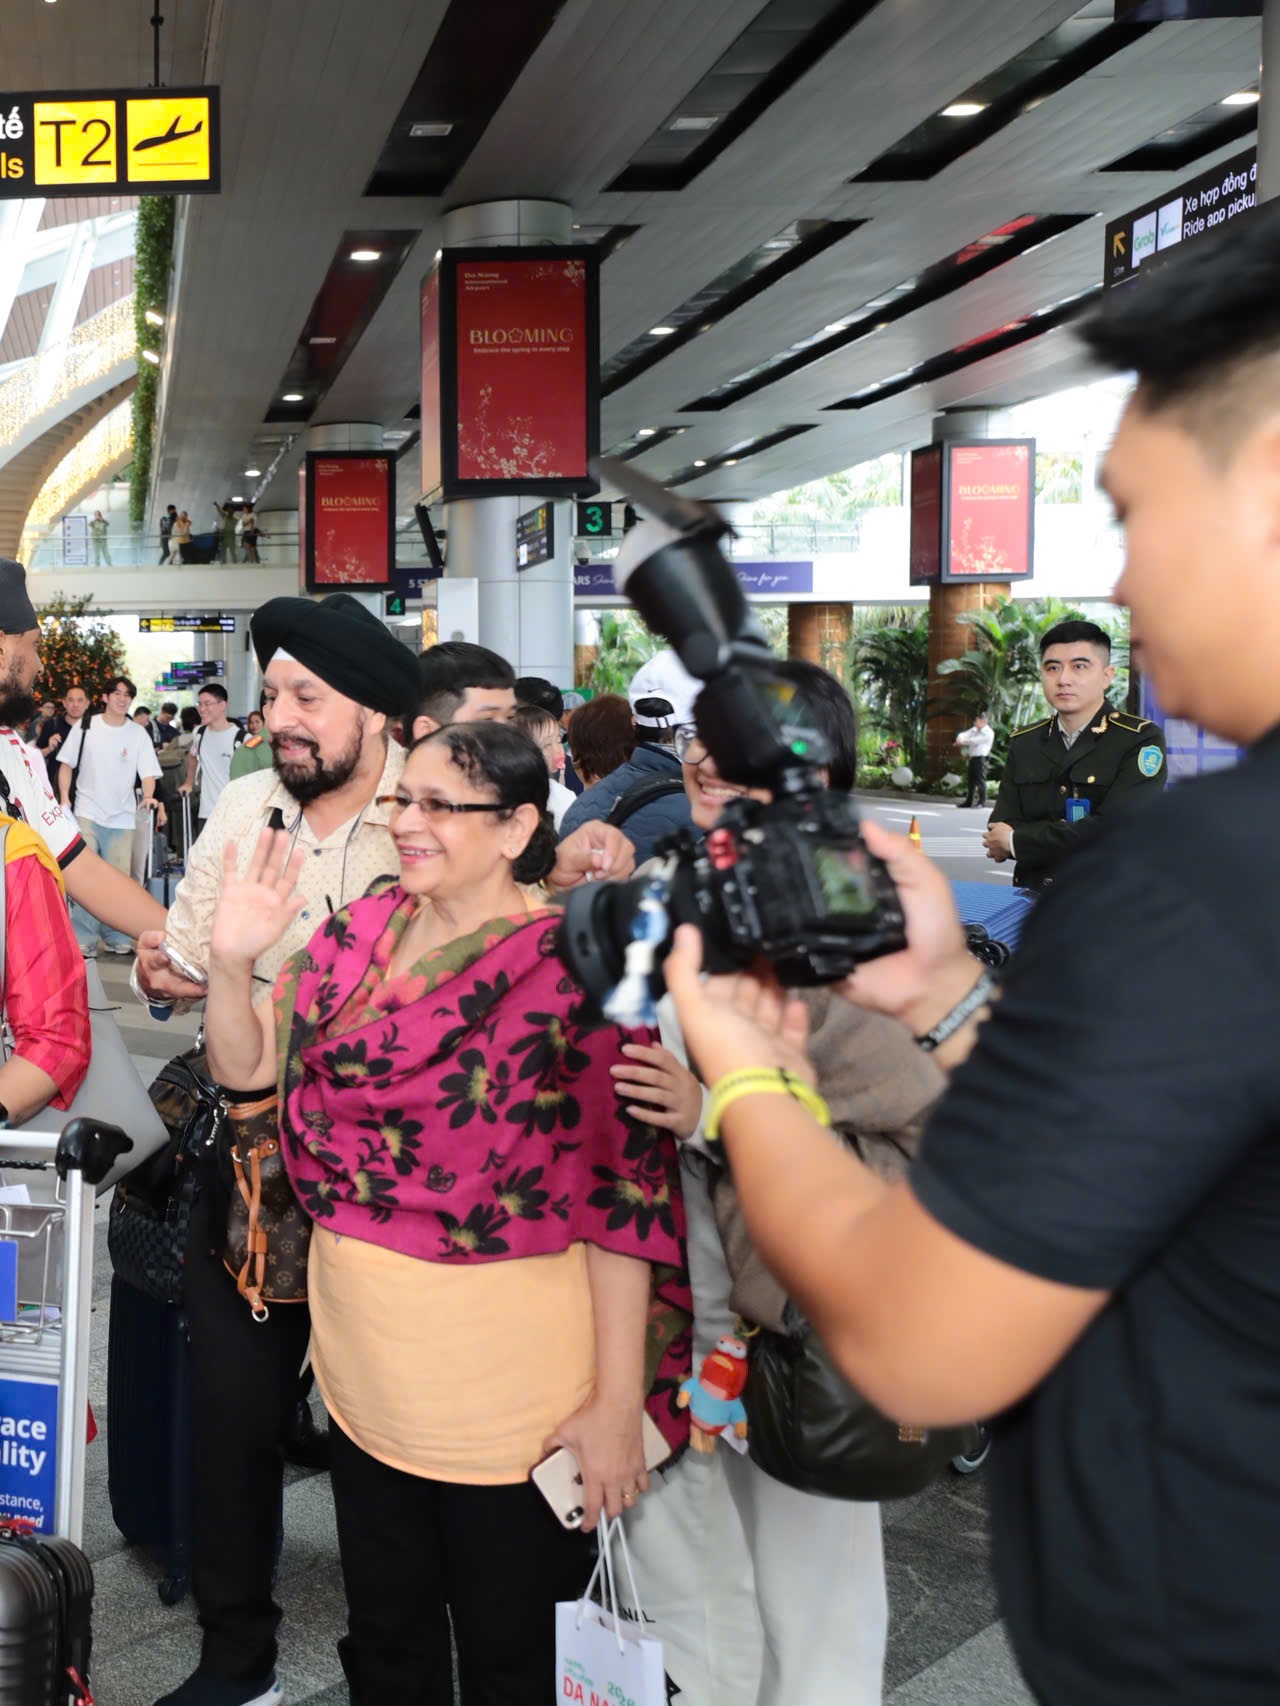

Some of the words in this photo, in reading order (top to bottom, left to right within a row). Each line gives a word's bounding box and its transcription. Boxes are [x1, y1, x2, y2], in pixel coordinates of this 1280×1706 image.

[39, 118, 112, 168] T2
[1184, 197, 1198, 215] Xe
[1200, 186, 1220, 207] hợp
[1222, 172, 1247, 196] đồng
[1183, 217, 1205, 239] Ride
[1207, 207, 1226, 227] app
[1228, 193, 1257, 218] picku
[585, 506, 603, 533] 3
[391, 598, 401, 614] 4
[563, 1675, 585, 1706] DA
